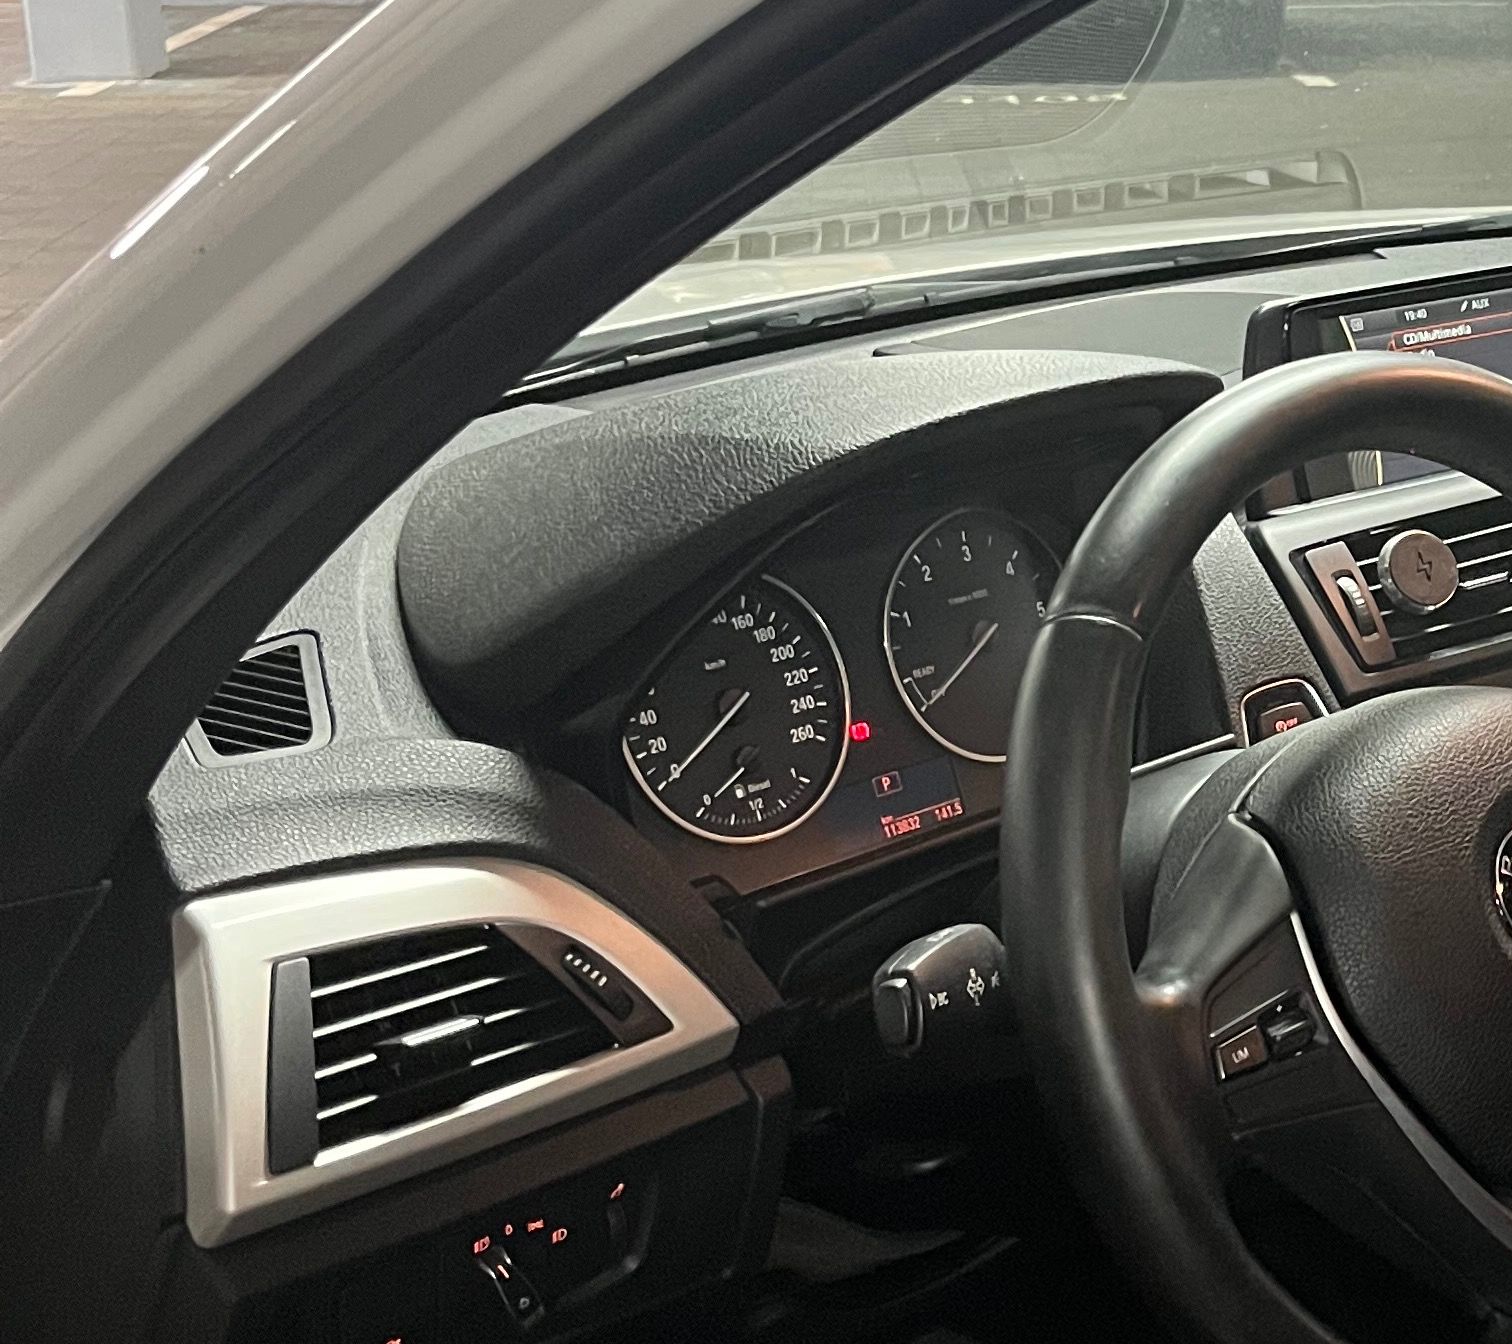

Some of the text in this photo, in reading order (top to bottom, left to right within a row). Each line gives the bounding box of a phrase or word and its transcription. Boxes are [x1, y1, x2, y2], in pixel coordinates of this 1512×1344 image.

[1403, 324, 1472, 346] CD/Multimedia
[961, 545, 972, 562] 3
[921, 564, 933, 582] 2
[1005, 560, 1015, 576] 4
[1036, 600, 1046, 618] 5
[731, 613, 754, 631] 160
[902, 610, 912, 628] 1
[753, 625, 776, 644] 180
[769, 644, 795, 663] 200
[783, 668, 809, 687] 220
[790, 694, 815, 714] 240
[639, 709, 657, 726] 40
[790, 724, 815, 743] 260
[648, 736, 667, 754] 20
[881, 776, 891, 792] P
[702, 794, 712, 806] 0
